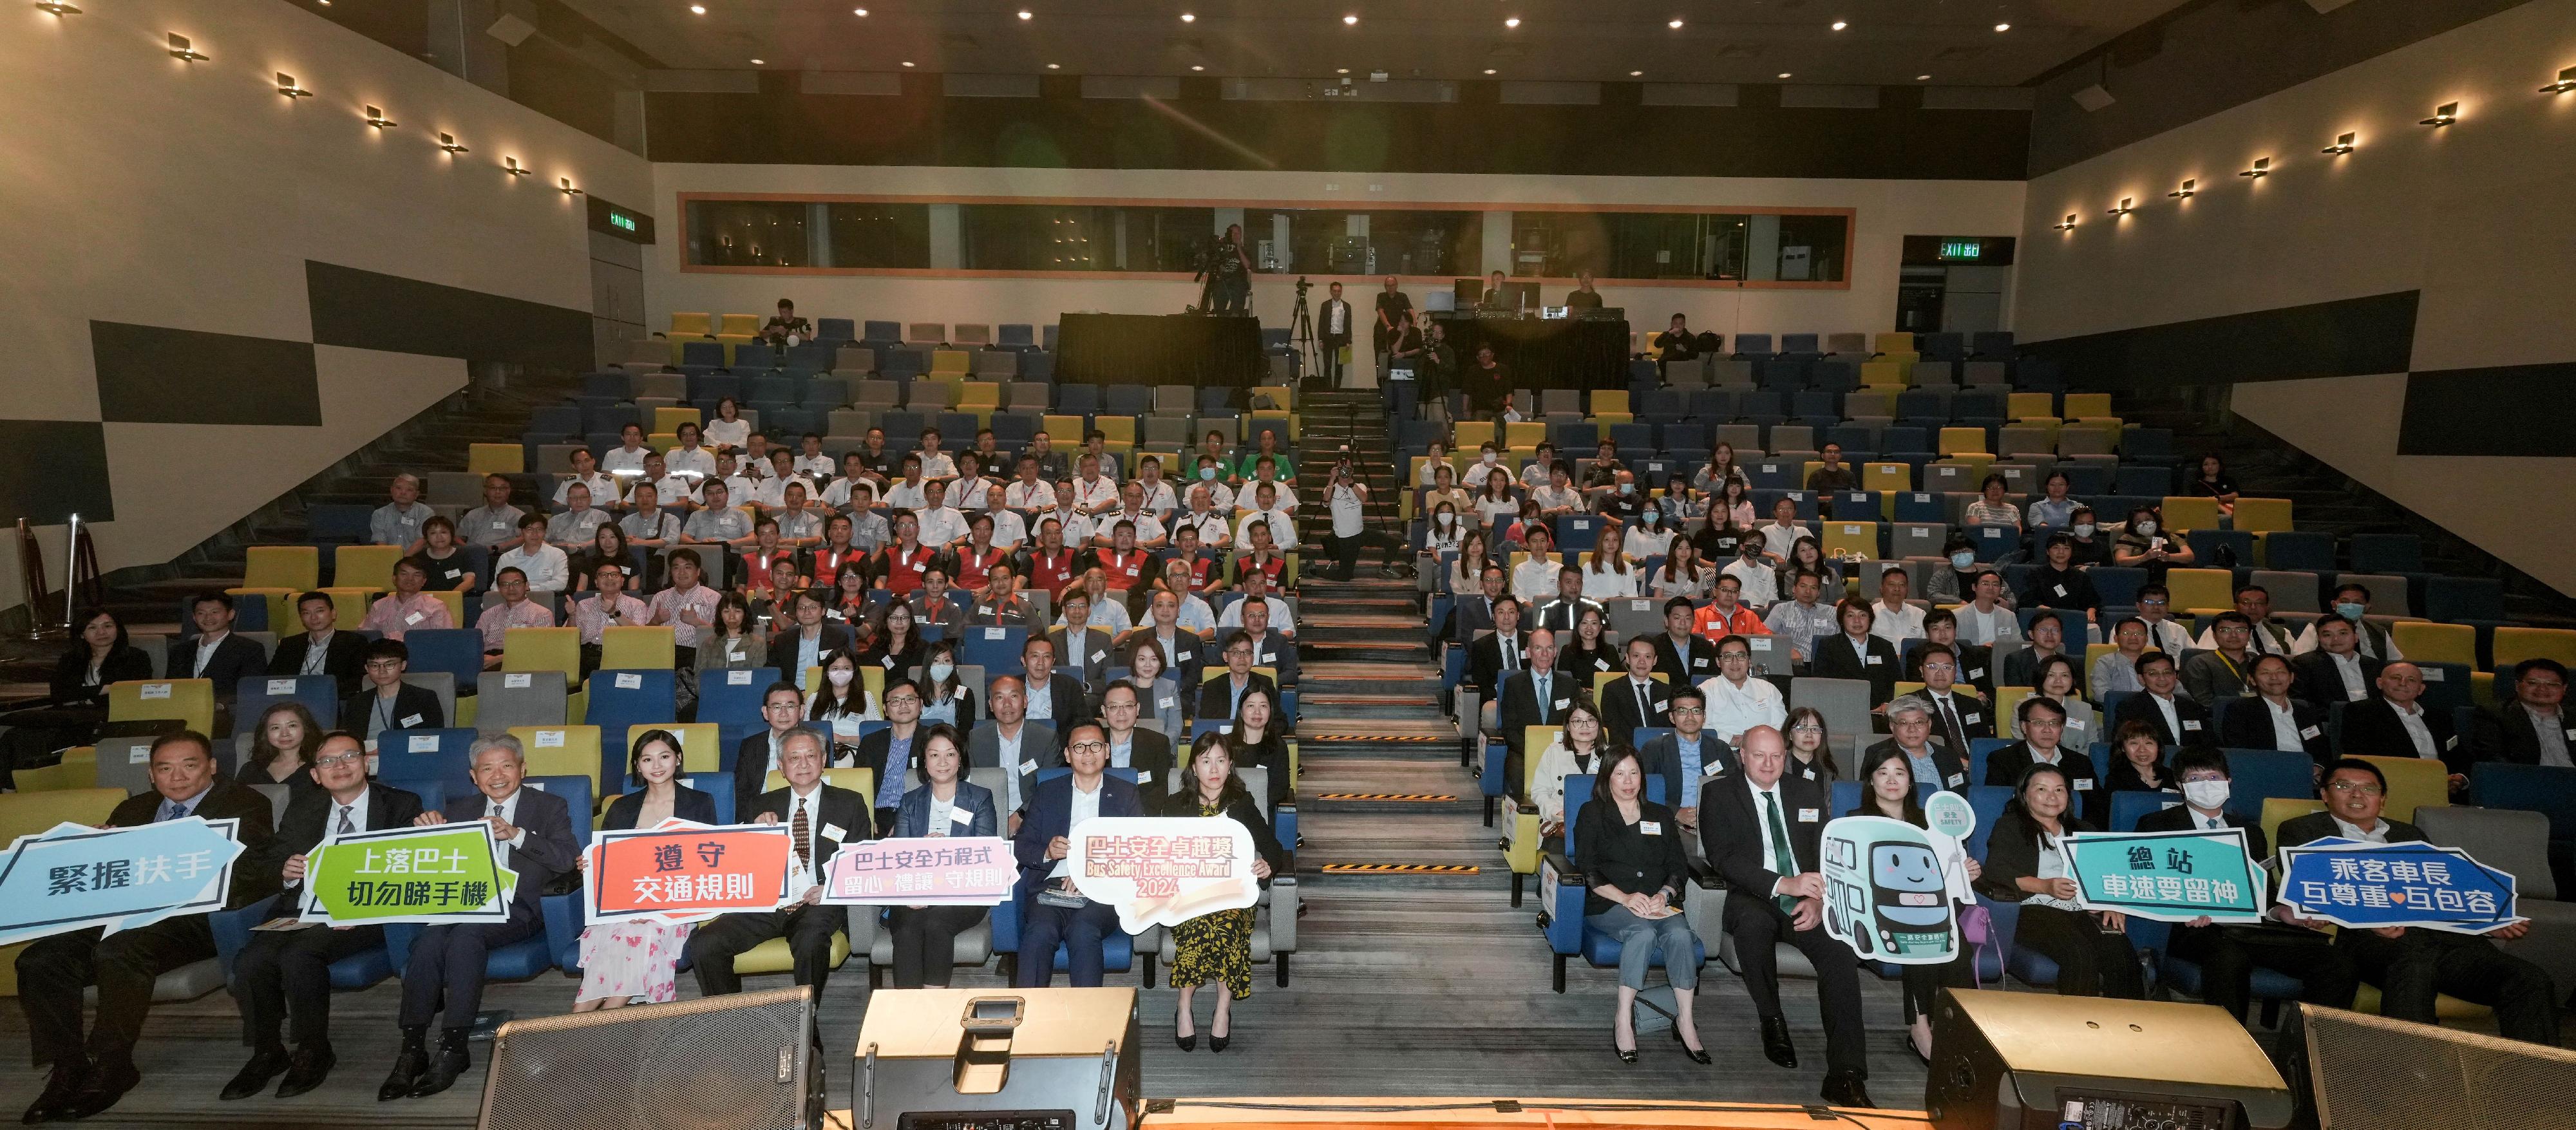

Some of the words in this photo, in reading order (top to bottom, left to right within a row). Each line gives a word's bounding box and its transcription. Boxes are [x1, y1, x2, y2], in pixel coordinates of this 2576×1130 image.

[1941, 243, 1962, 256] EXIT
[1964, 243, 1979, 257] 出口
[654, 841, 725, 872] 遵守
[855, 846, 992, 871] 巴士安全方程式
[1086, 836, 1238, 859] 巴士安全卓越獎
[2127, 846, 2193, 874] 總站
[48, 850, 212, 896] 緊握扶手
[355, 848, 468, 874] 上落巴士
[1086, 860, 1106, 878] Bus
[1108, 860, 1142, 880] Safety
[1142, 860, 1197, 878] Excellence
[1198, 861, 1231, 878] Award
[2330, 858, 2452, 885] 乘客車長
[347, 881, 488, 906] 切勿睇手機
[633, 873, 753, 903] 交通規則
[844, 876, 883, 895] 留心
[895, 872, 933, 892] 禮讓
[945, 868, 1003, 889] 守規則
[1137, 879, 1180, 897] 2024
[2101, 874, 2239, 904] 車速要留神
[2299, 881, 2391, 908] 互尊重
[2402, 886, 2497, 914] 互包容
